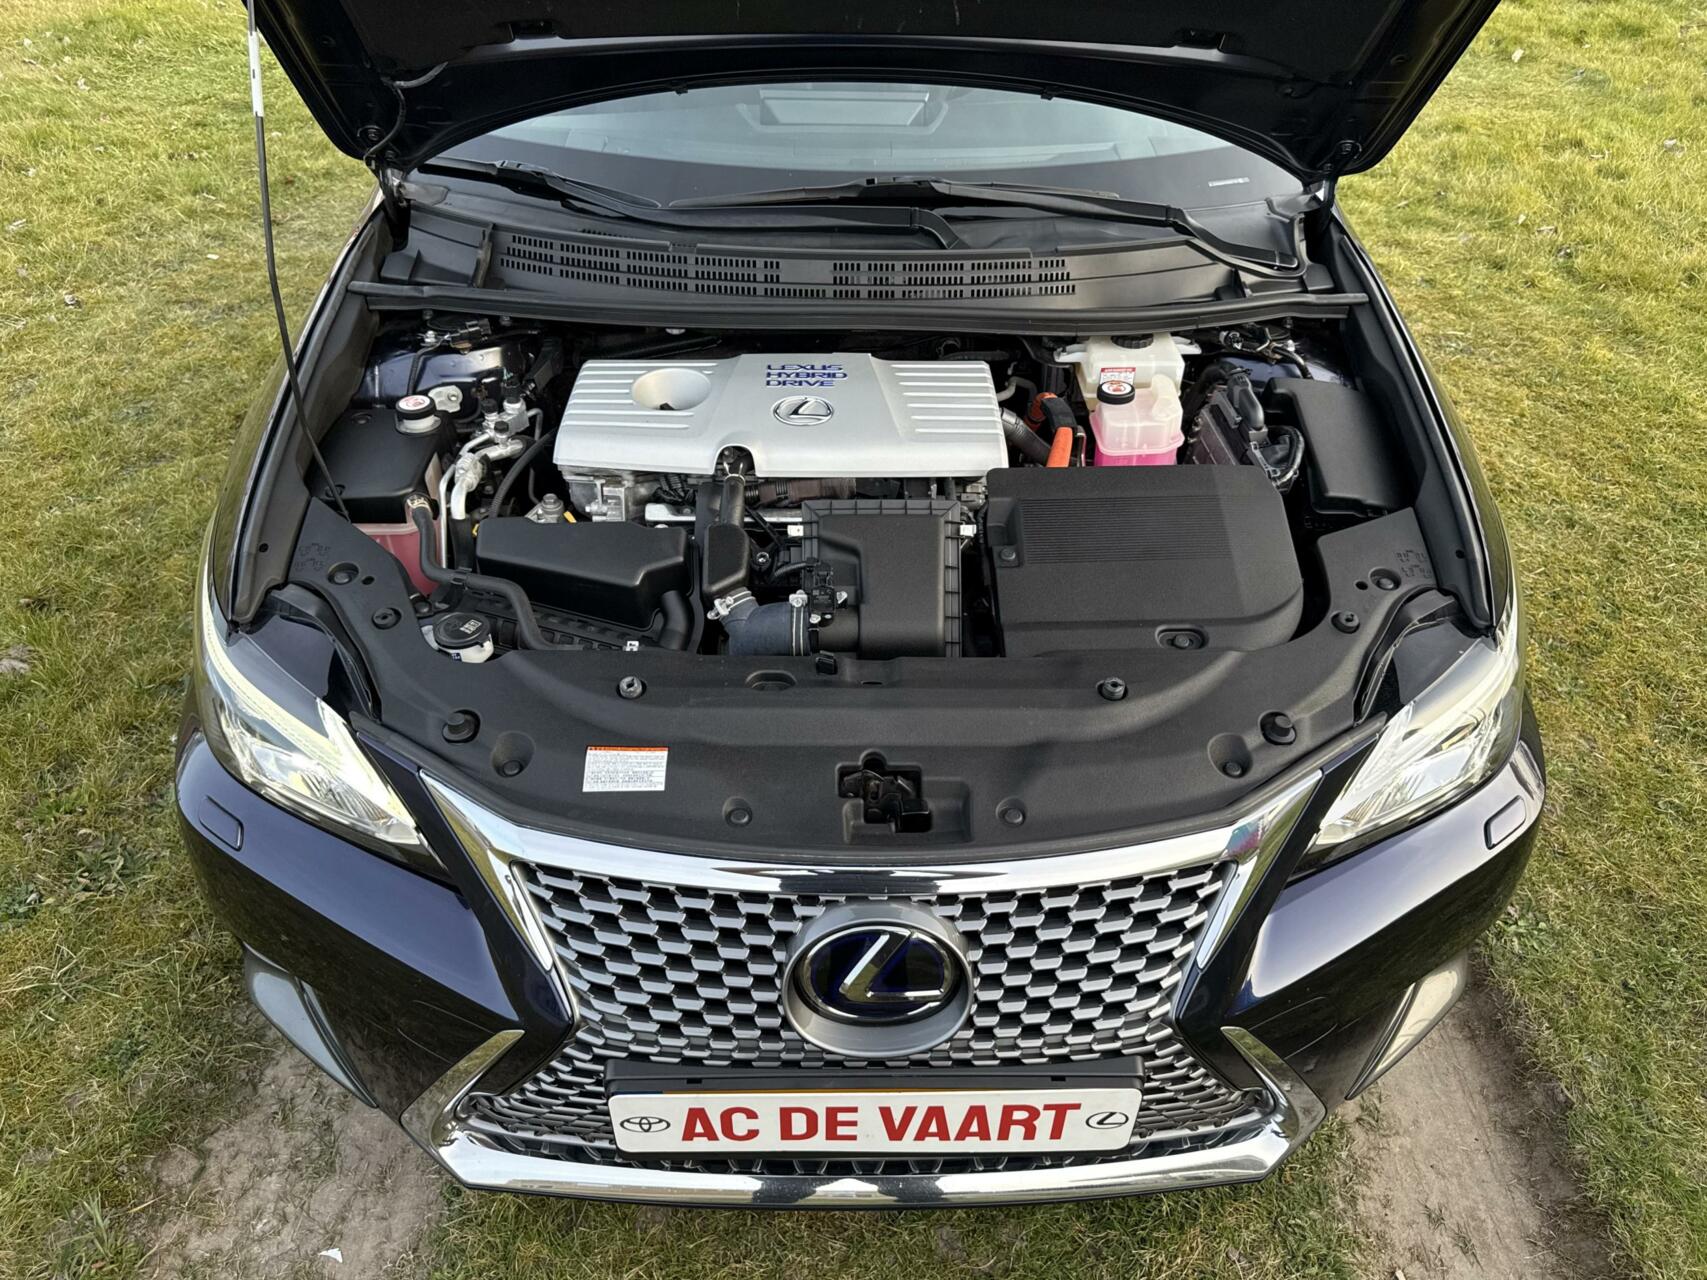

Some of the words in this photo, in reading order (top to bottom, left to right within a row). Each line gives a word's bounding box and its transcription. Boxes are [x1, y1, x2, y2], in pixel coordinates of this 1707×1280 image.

[682, 1106, 759, 1142] AC
[780, 1106, 858, 1141] DE
[879, 1103, 1082, 1142] VAART
